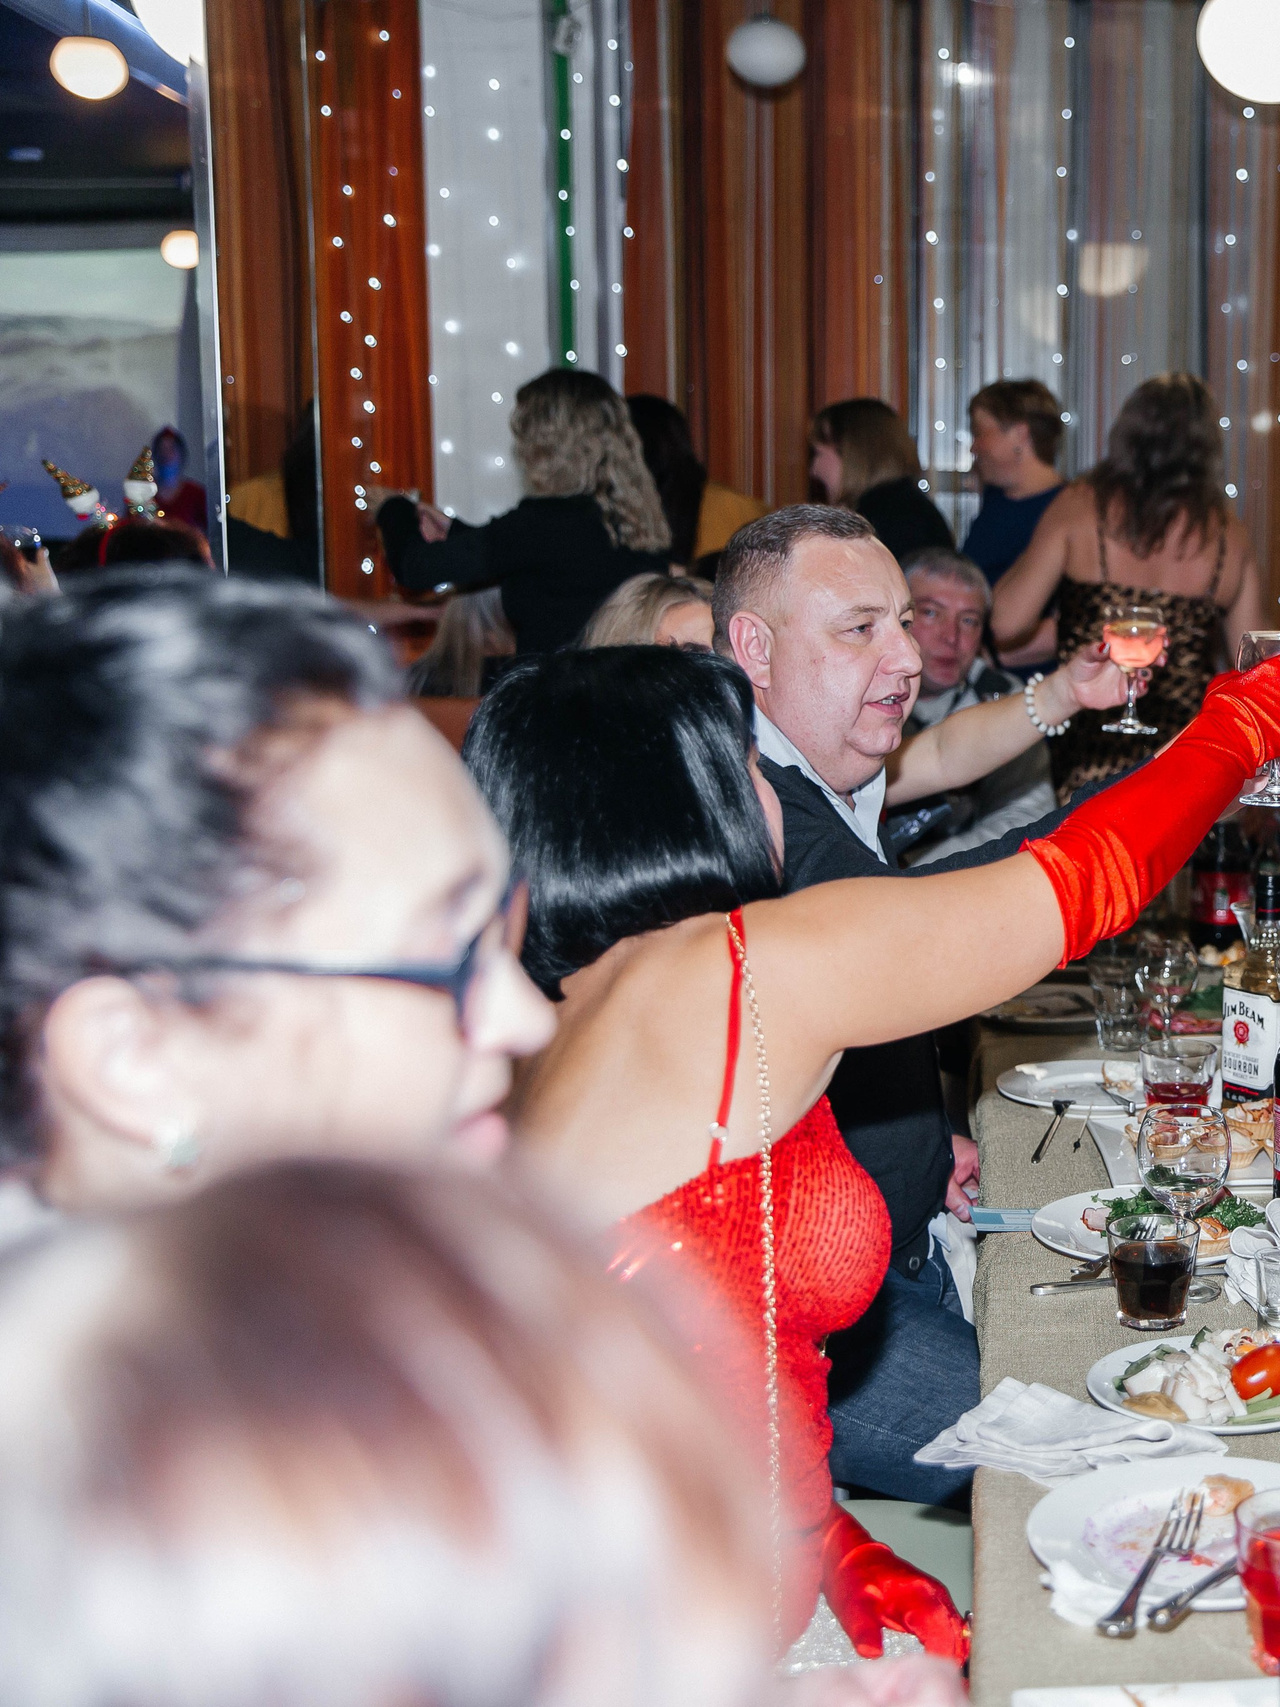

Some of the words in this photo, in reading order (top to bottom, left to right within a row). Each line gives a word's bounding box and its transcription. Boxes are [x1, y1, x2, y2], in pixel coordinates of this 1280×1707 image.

[1223, 1002, 1237, 1021] JIM
[1239, 1001, 1265, 1030] BEAM
[1223, 1056, 1259, 1076] BOURBON
